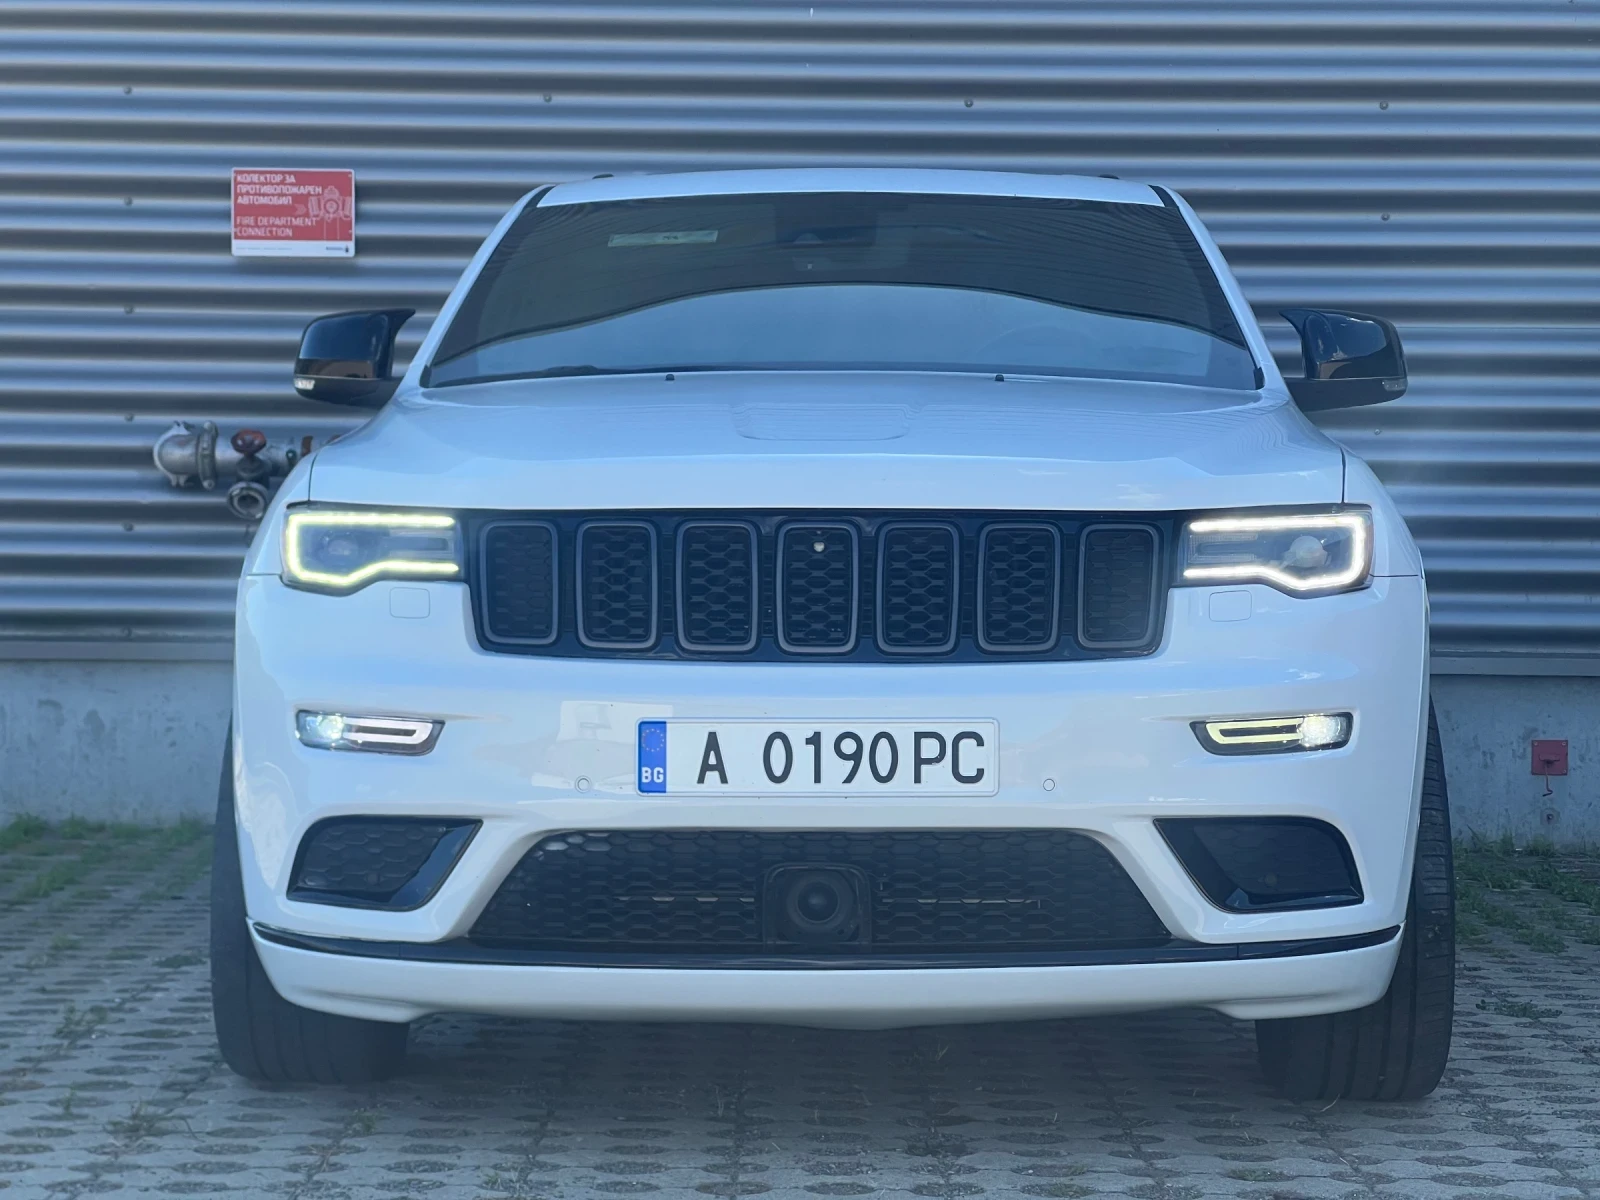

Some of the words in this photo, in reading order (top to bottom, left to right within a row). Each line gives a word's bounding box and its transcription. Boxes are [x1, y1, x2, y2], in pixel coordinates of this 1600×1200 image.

[237, 173, 283, 183] КОЛЕКТОР
[284, 174, 296, 183] ЗА
[236, 184, 322, 194] ПРОТИВОПОЖАРЕН
[237, 195, 292, 205] АВТОМОБИЛ
[236, 216, 255, 225] FIRE
[257, 216, 317, 226] DEPARTMENT
[236, 227, 293, 237] CONNECTION
[696, 731, 729, 784] A
[641, 767, 664, 783] BG
